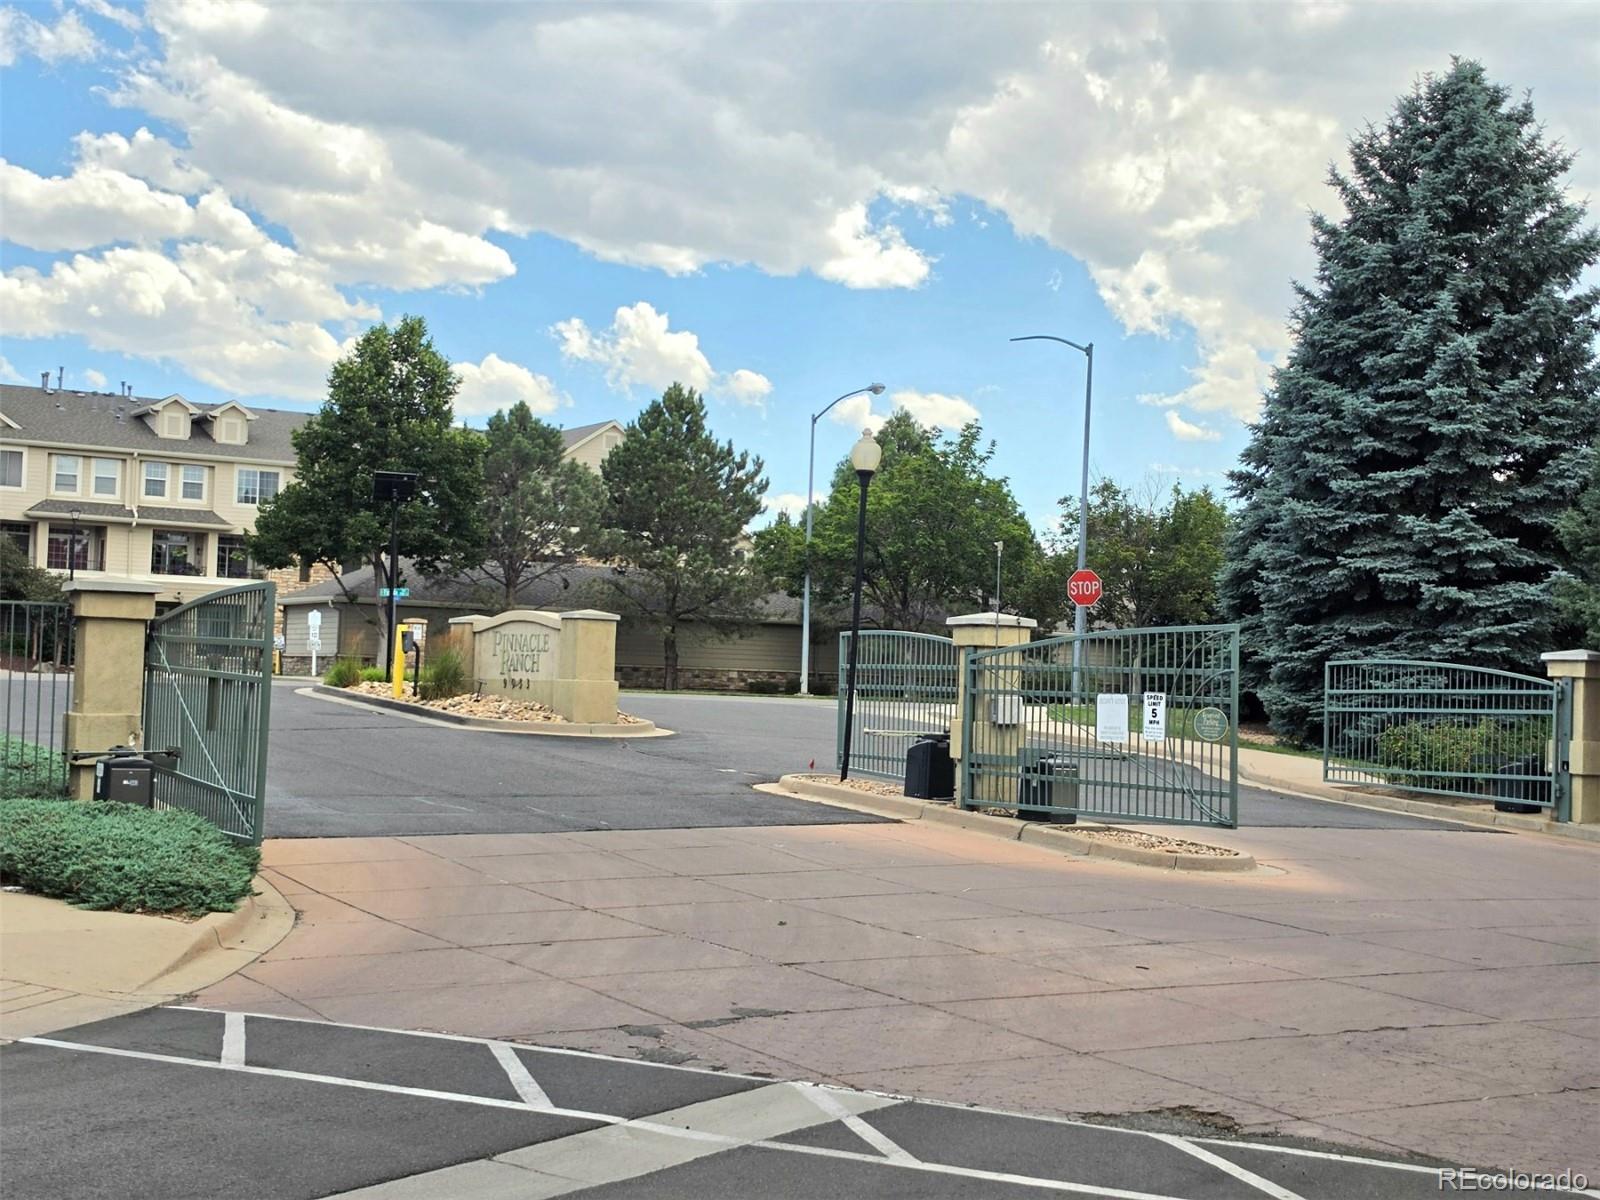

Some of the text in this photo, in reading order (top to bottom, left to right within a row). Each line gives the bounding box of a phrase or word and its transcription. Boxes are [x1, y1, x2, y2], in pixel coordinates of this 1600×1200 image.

[1070, 581, 1099, 595] STOP
[493, 630, 550, 657] PINNACLE
[500, 649, 541, 675] RANCH
[1151, 708, 1158, 719] 5
